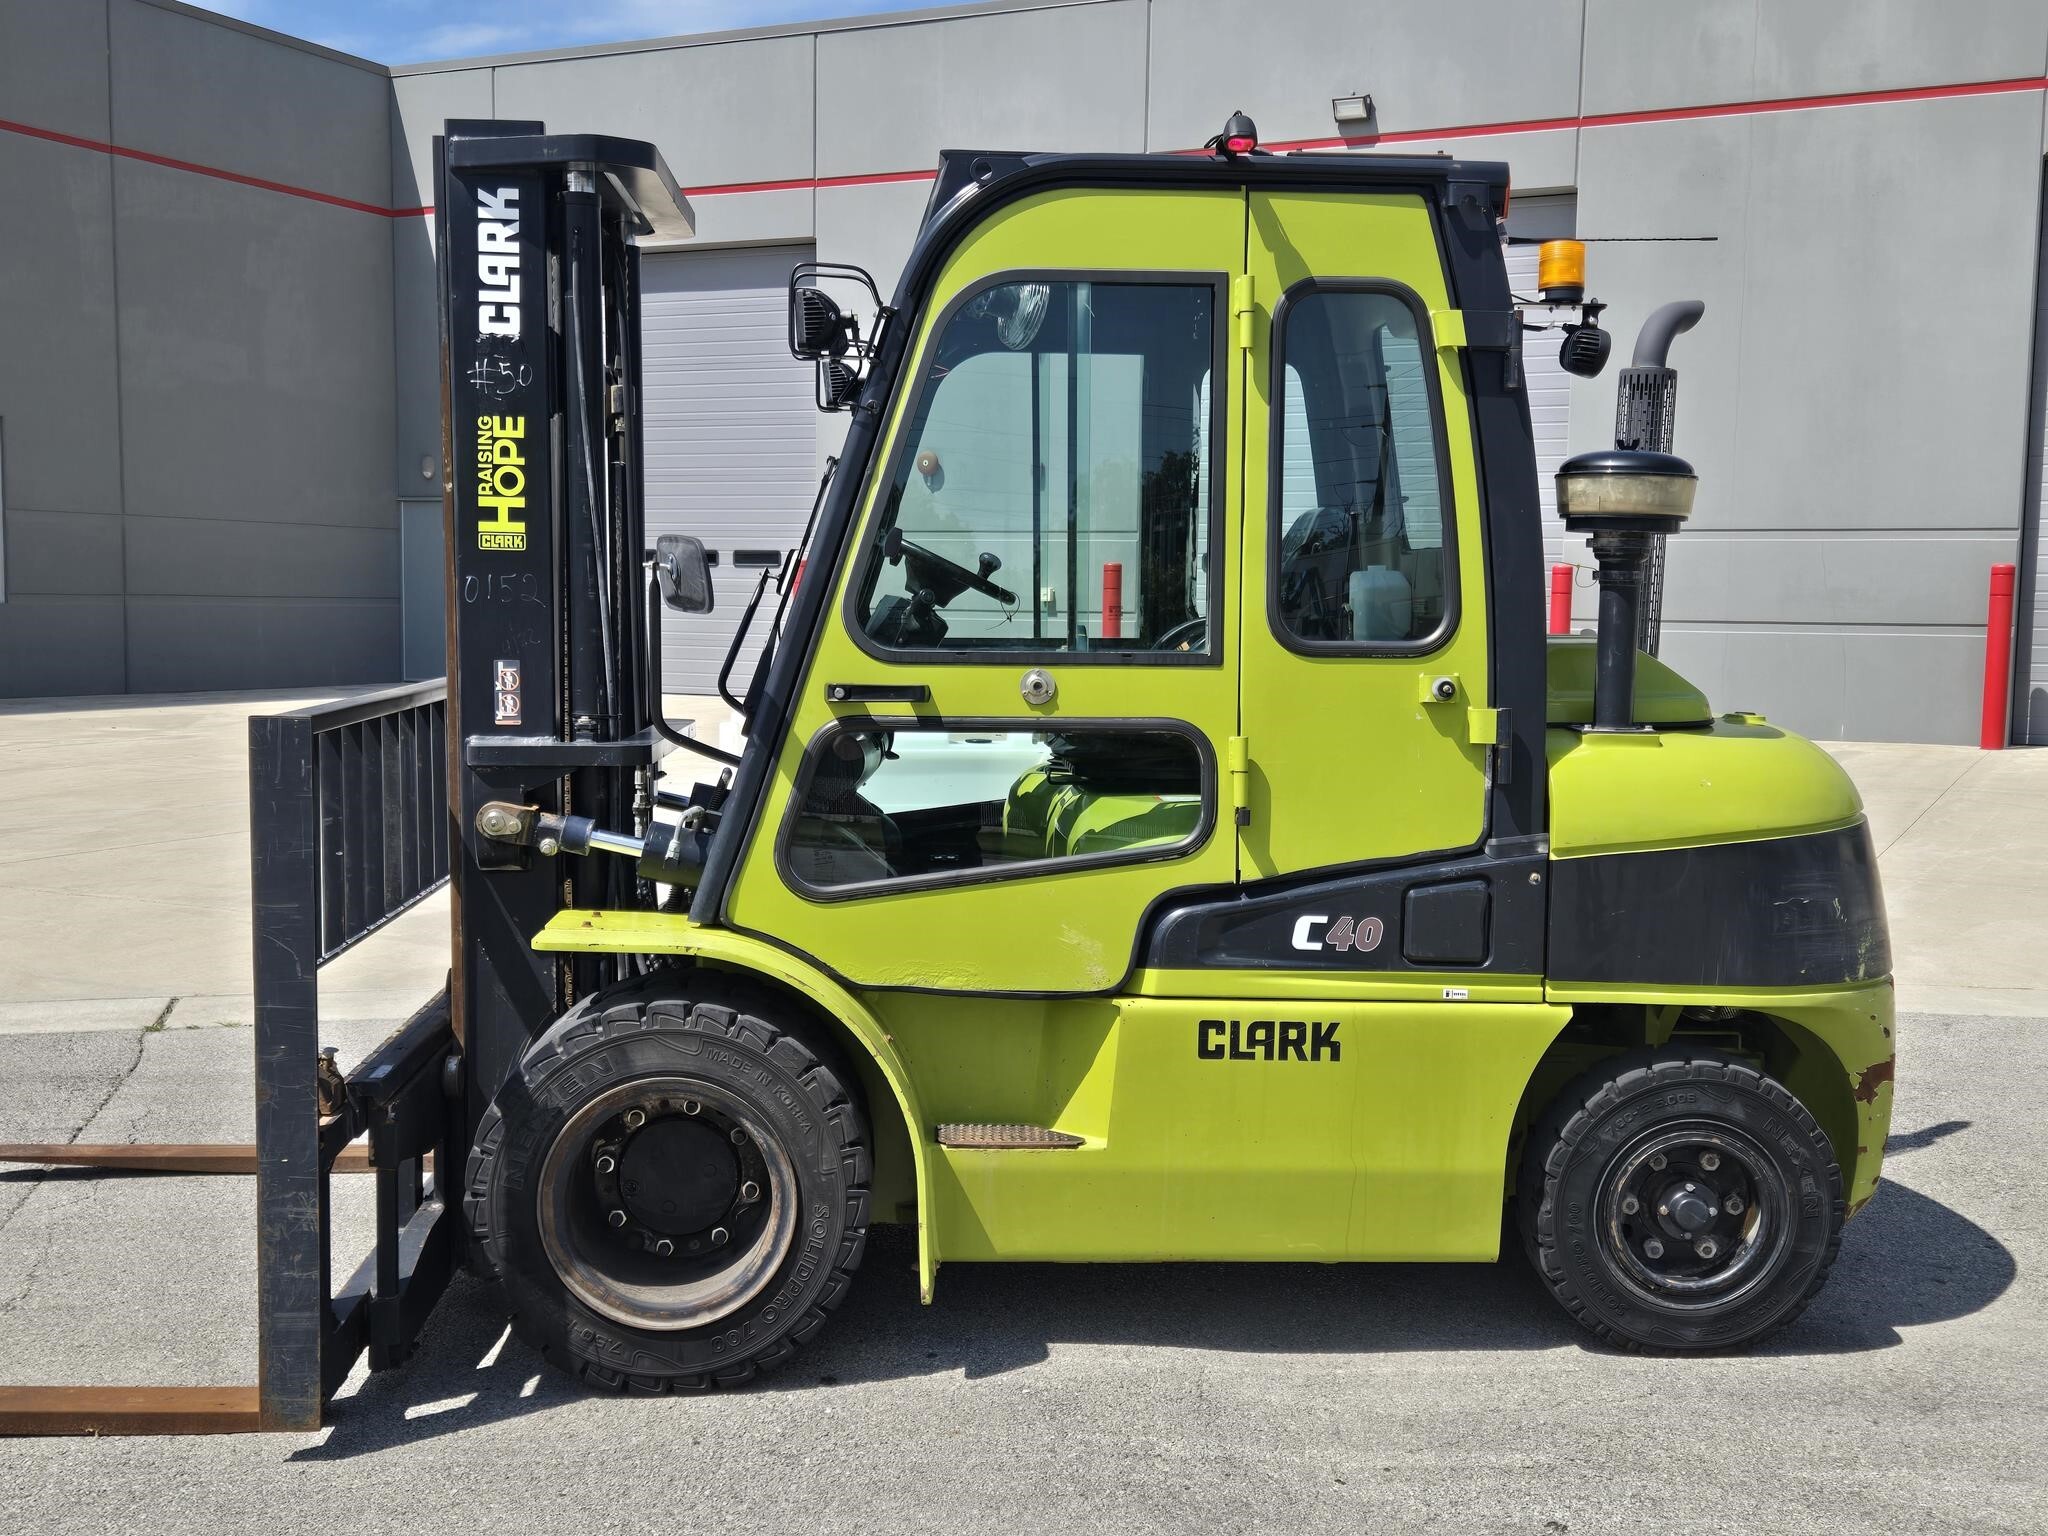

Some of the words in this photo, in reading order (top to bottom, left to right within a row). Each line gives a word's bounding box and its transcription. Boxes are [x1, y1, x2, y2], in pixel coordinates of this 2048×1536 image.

[477, 187, 520, 335] CLARK
[477, 416, 494, 495] RAISING
[478, 416, 526, 533] HOPE
[481, 534, 524, 550] CLARK
[1291, 915, 1384, 952] C40
[1198, 1020, 1341, 1062] CLARK
[706, 1047, 752, 1074] MADE
[754, 1069, 773, 1088] IN
[771, 1084, 814, 1136] KOREA
[1760, 1117, 1820, 1220] NEXEN
[761, 1204, 830, 1324] SOLIDPRO
